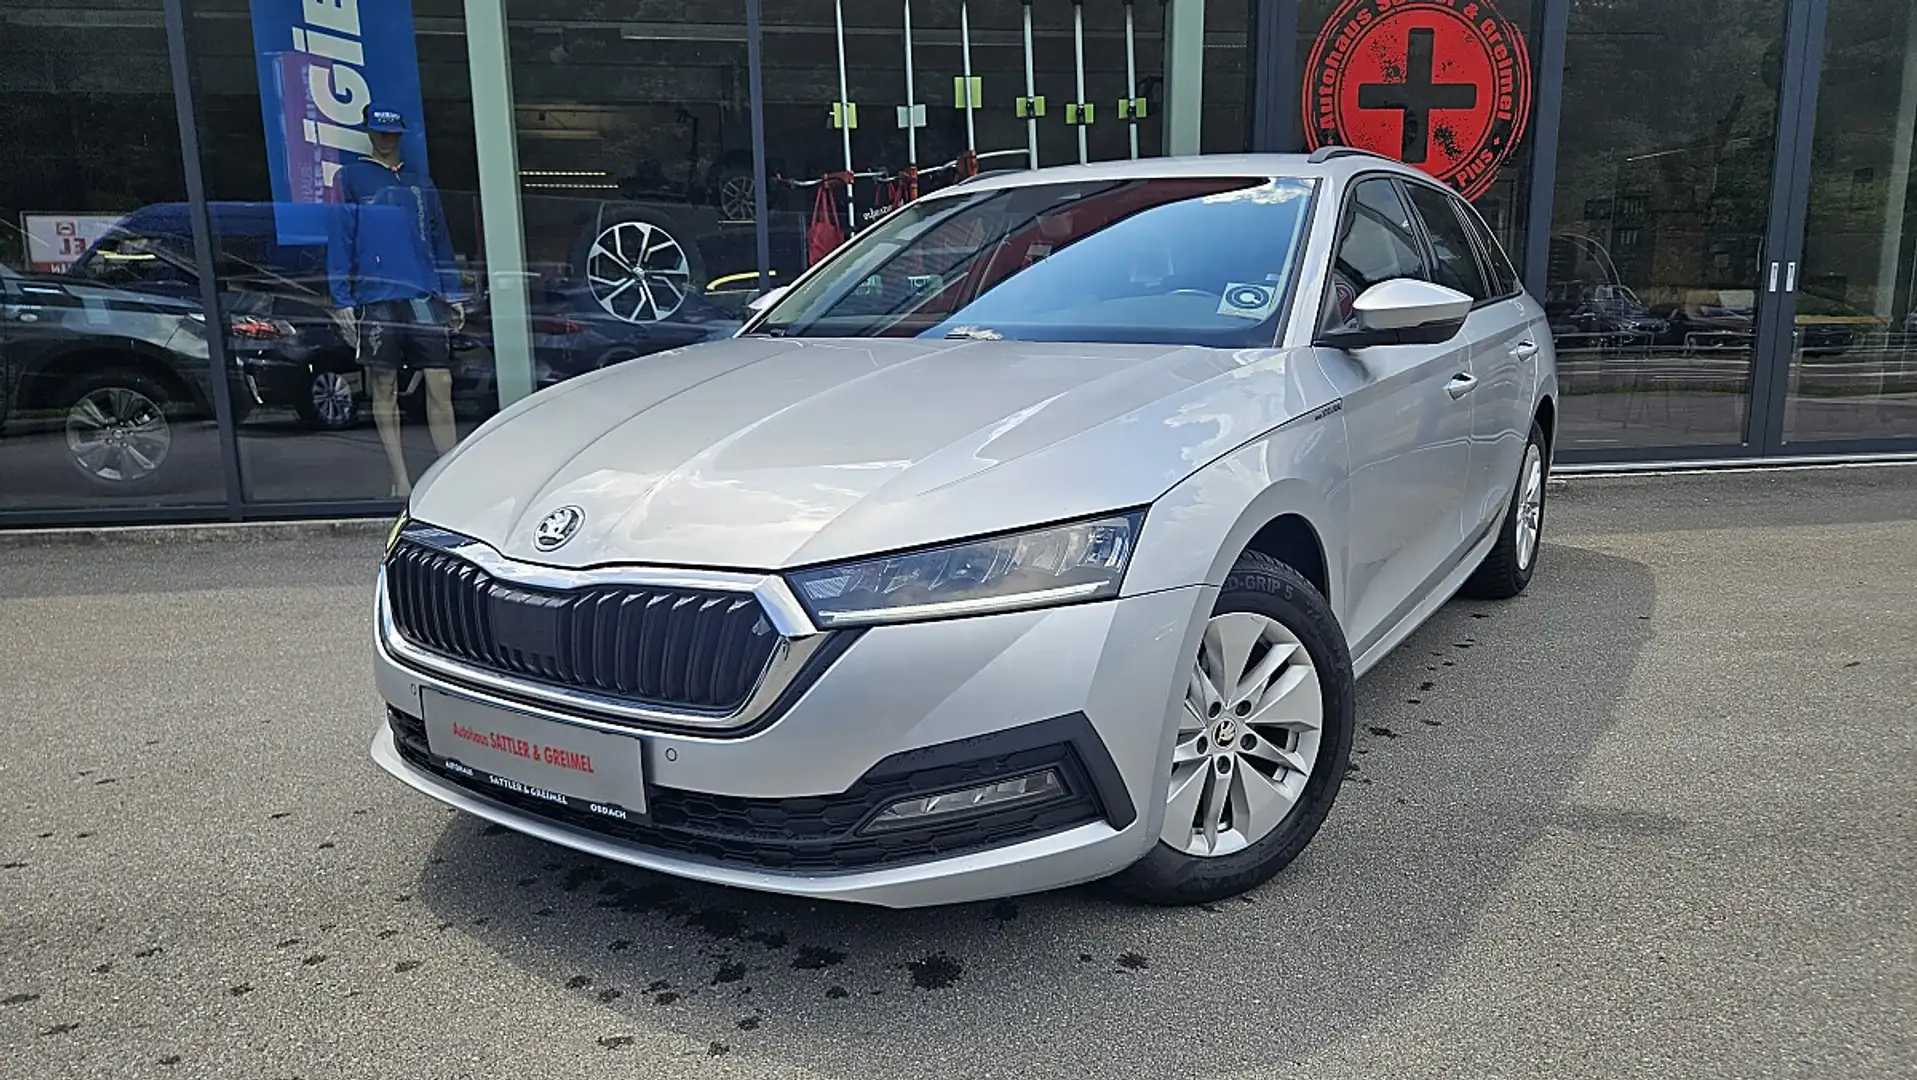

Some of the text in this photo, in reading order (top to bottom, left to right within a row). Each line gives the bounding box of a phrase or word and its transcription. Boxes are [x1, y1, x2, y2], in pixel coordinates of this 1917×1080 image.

[1319, 8, 1373, 130] Autohaus
[1480, 18, 1514, 121] Greimel
[1456, 149, 1493, 187] Plus
[1284, 584, 1294, 600] 5
[453, 722, 595, 773] Autohaus SATTLER & GREIMEL
[489, 775, 522, 792] SATTLER
[590, 803, 627, 820] OBDACH
